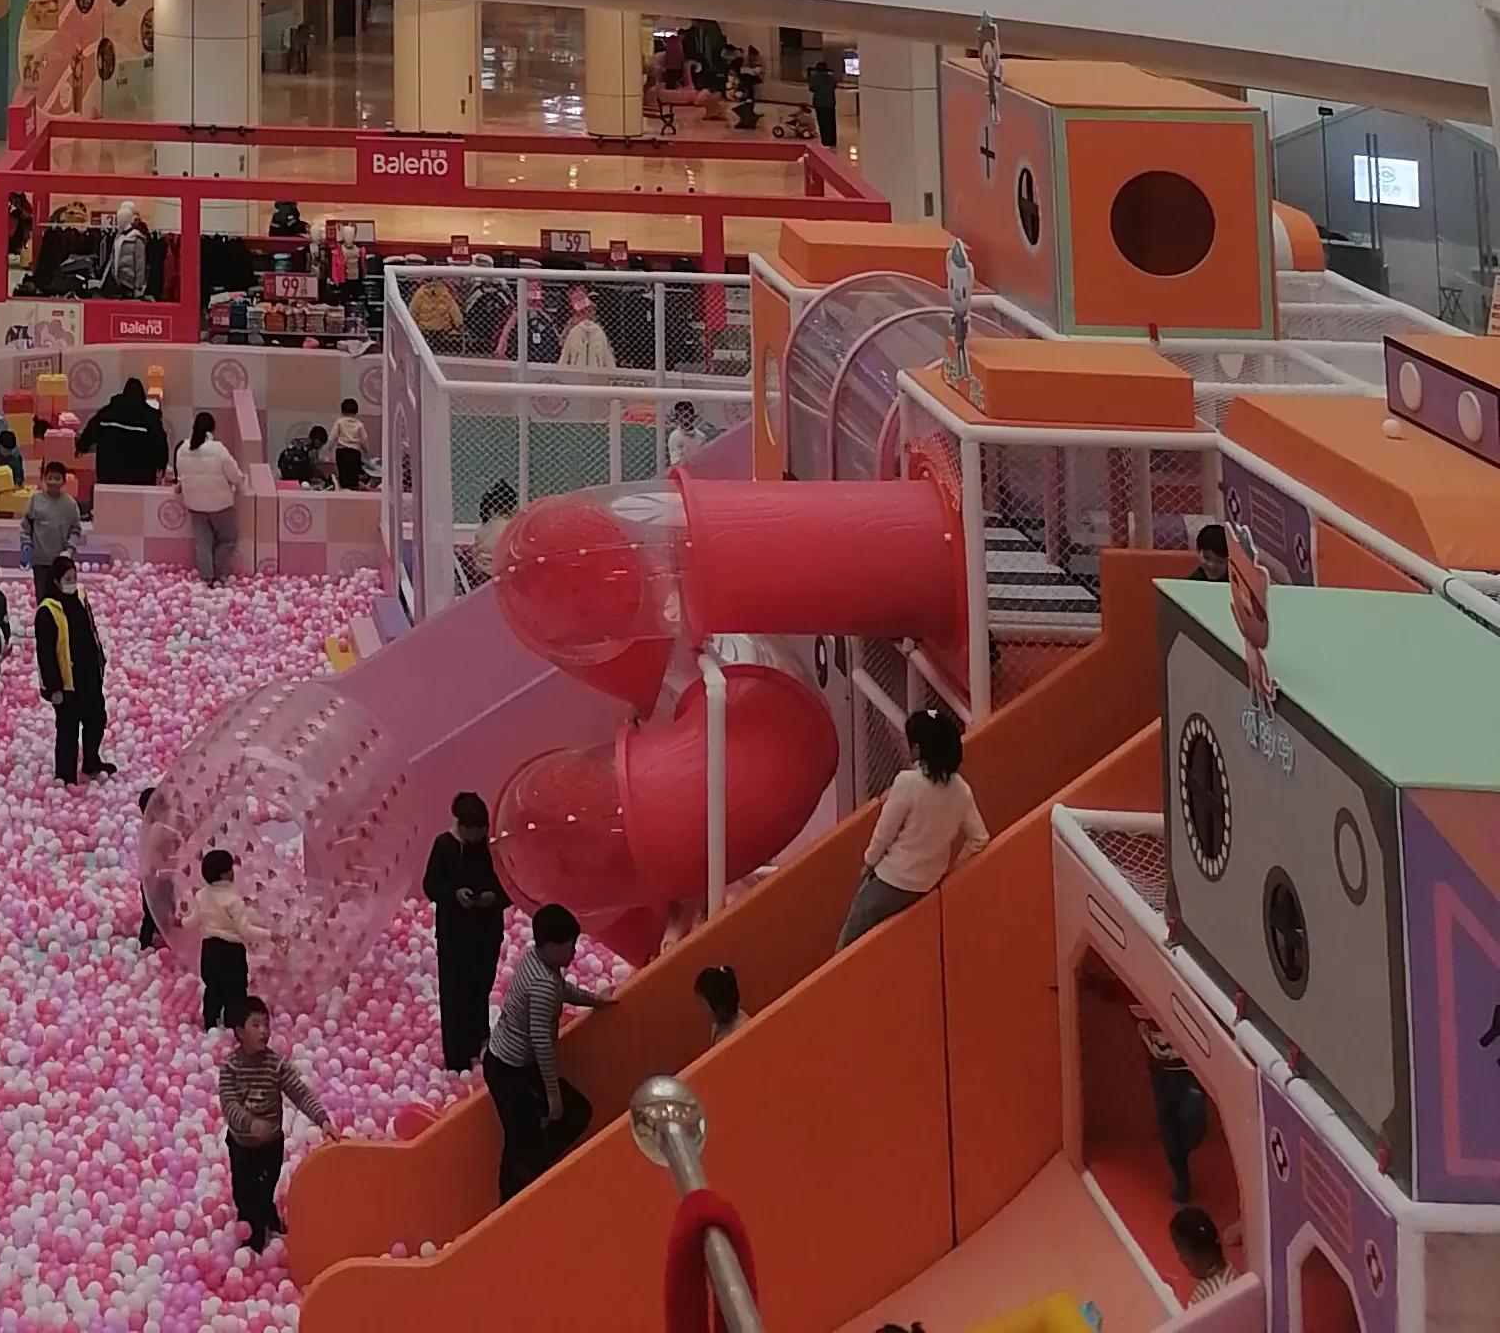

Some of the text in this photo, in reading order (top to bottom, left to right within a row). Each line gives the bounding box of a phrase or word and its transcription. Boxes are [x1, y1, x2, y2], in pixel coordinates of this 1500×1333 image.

[372, 152, 448, 176] Baleno
[281, 275, 300, 295] 99
[119, 321, 162, 335] Baleno
